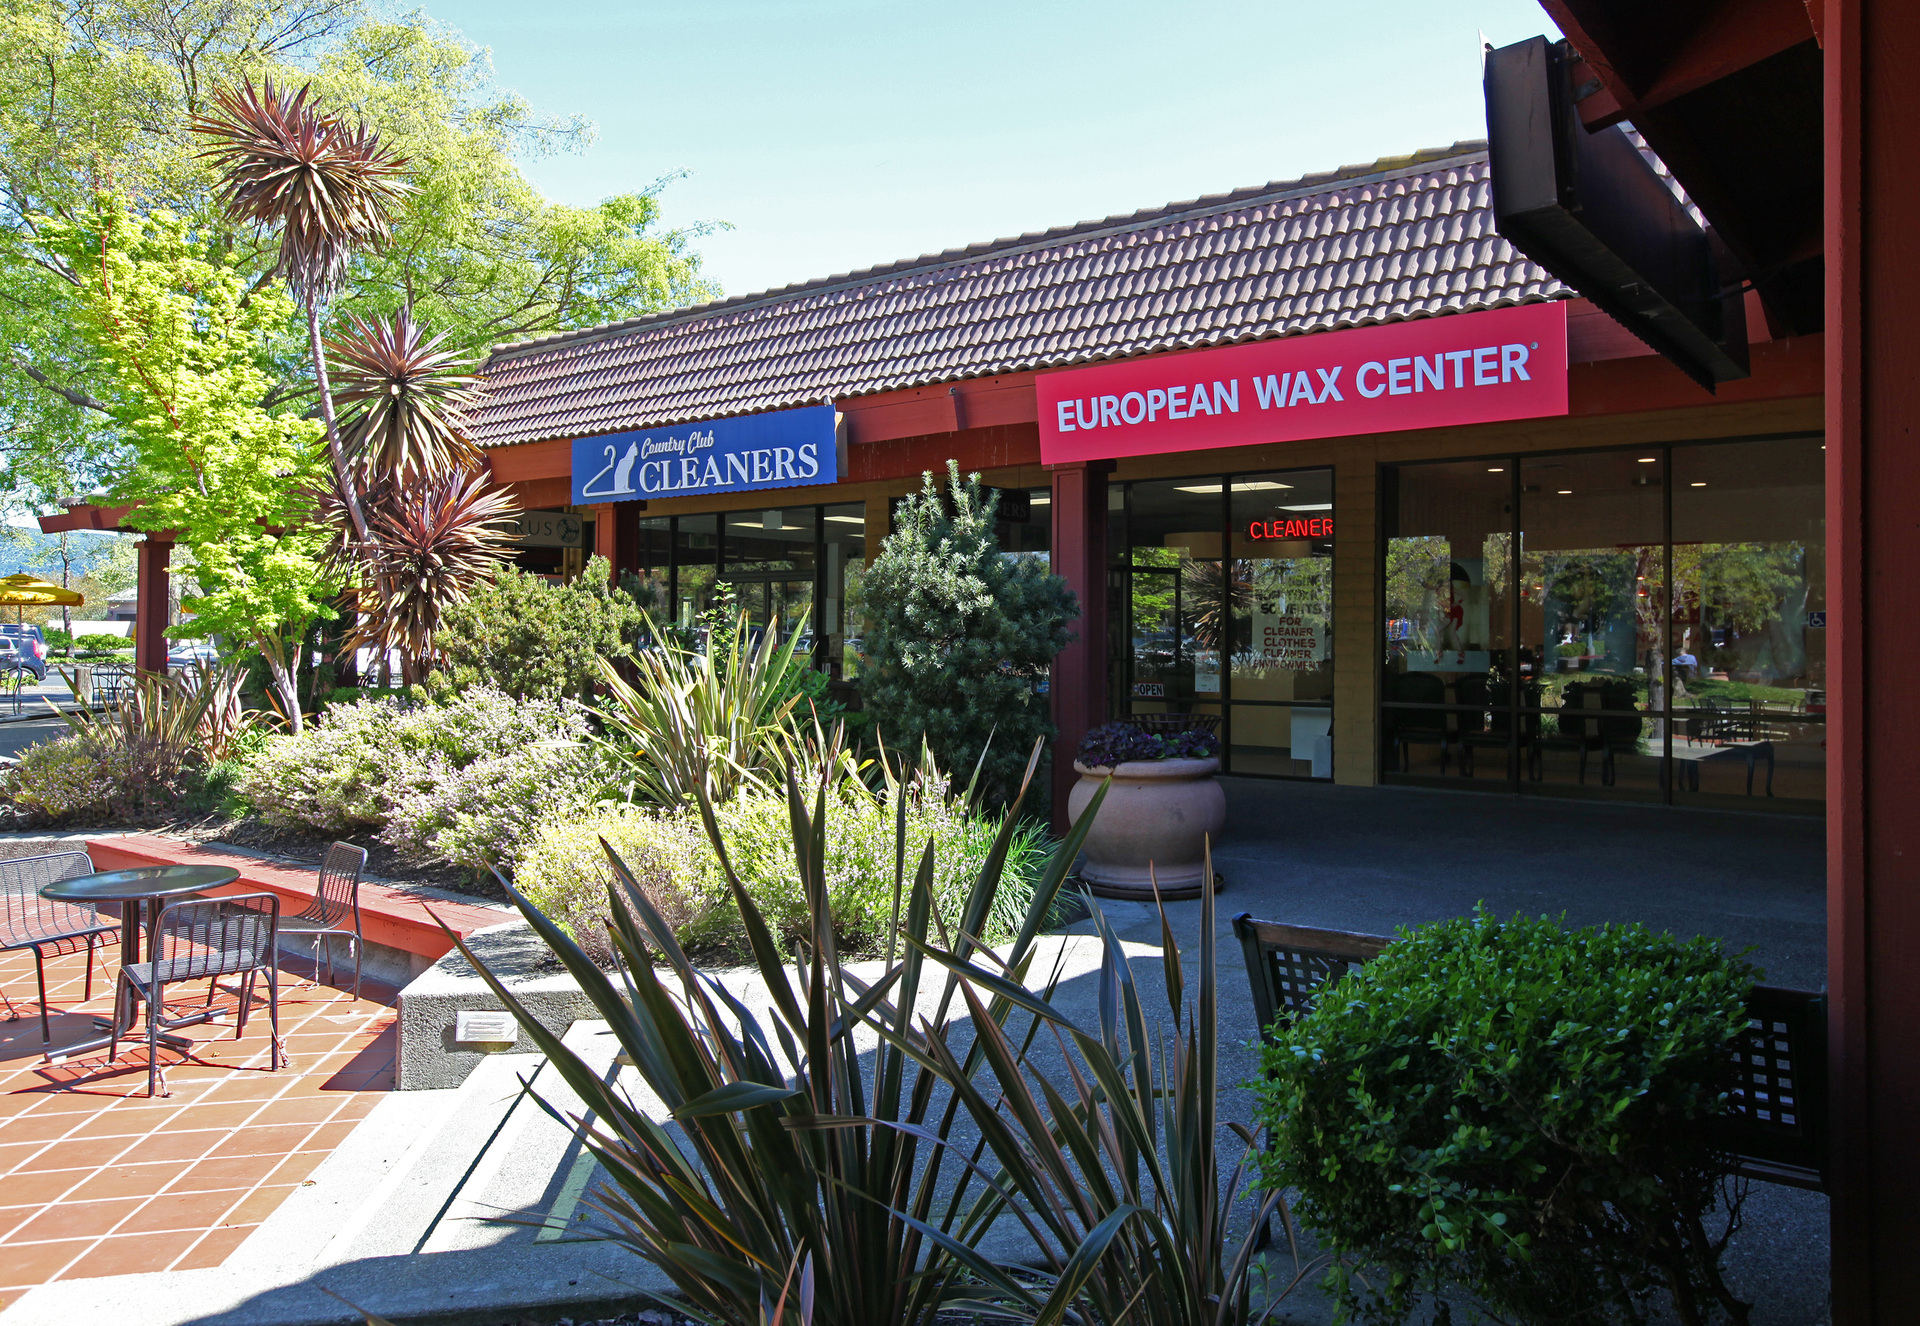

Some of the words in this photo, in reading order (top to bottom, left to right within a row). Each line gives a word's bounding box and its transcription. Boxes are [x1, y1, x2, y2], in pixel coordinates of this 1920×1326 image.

[1057, 378, 1240, 432] EUROPEAN
[1252, 365, 1344, 410] WAX
[1355, 342, 1532, 399] CENTER
[640, 436, 686, 459] Country
[687, 429, 714, 454] Club
[638, 443, 819, 492] CLEANERS
[1279, 616, 1302, 626] FOR
[1263, 627, 1314, 637] CLEANER
[1263, 637, 1317, 648] CLOTHES
[1263, 648, 1312, 659] CLEANER
[1139, 684, 1163, 696] OPEN
